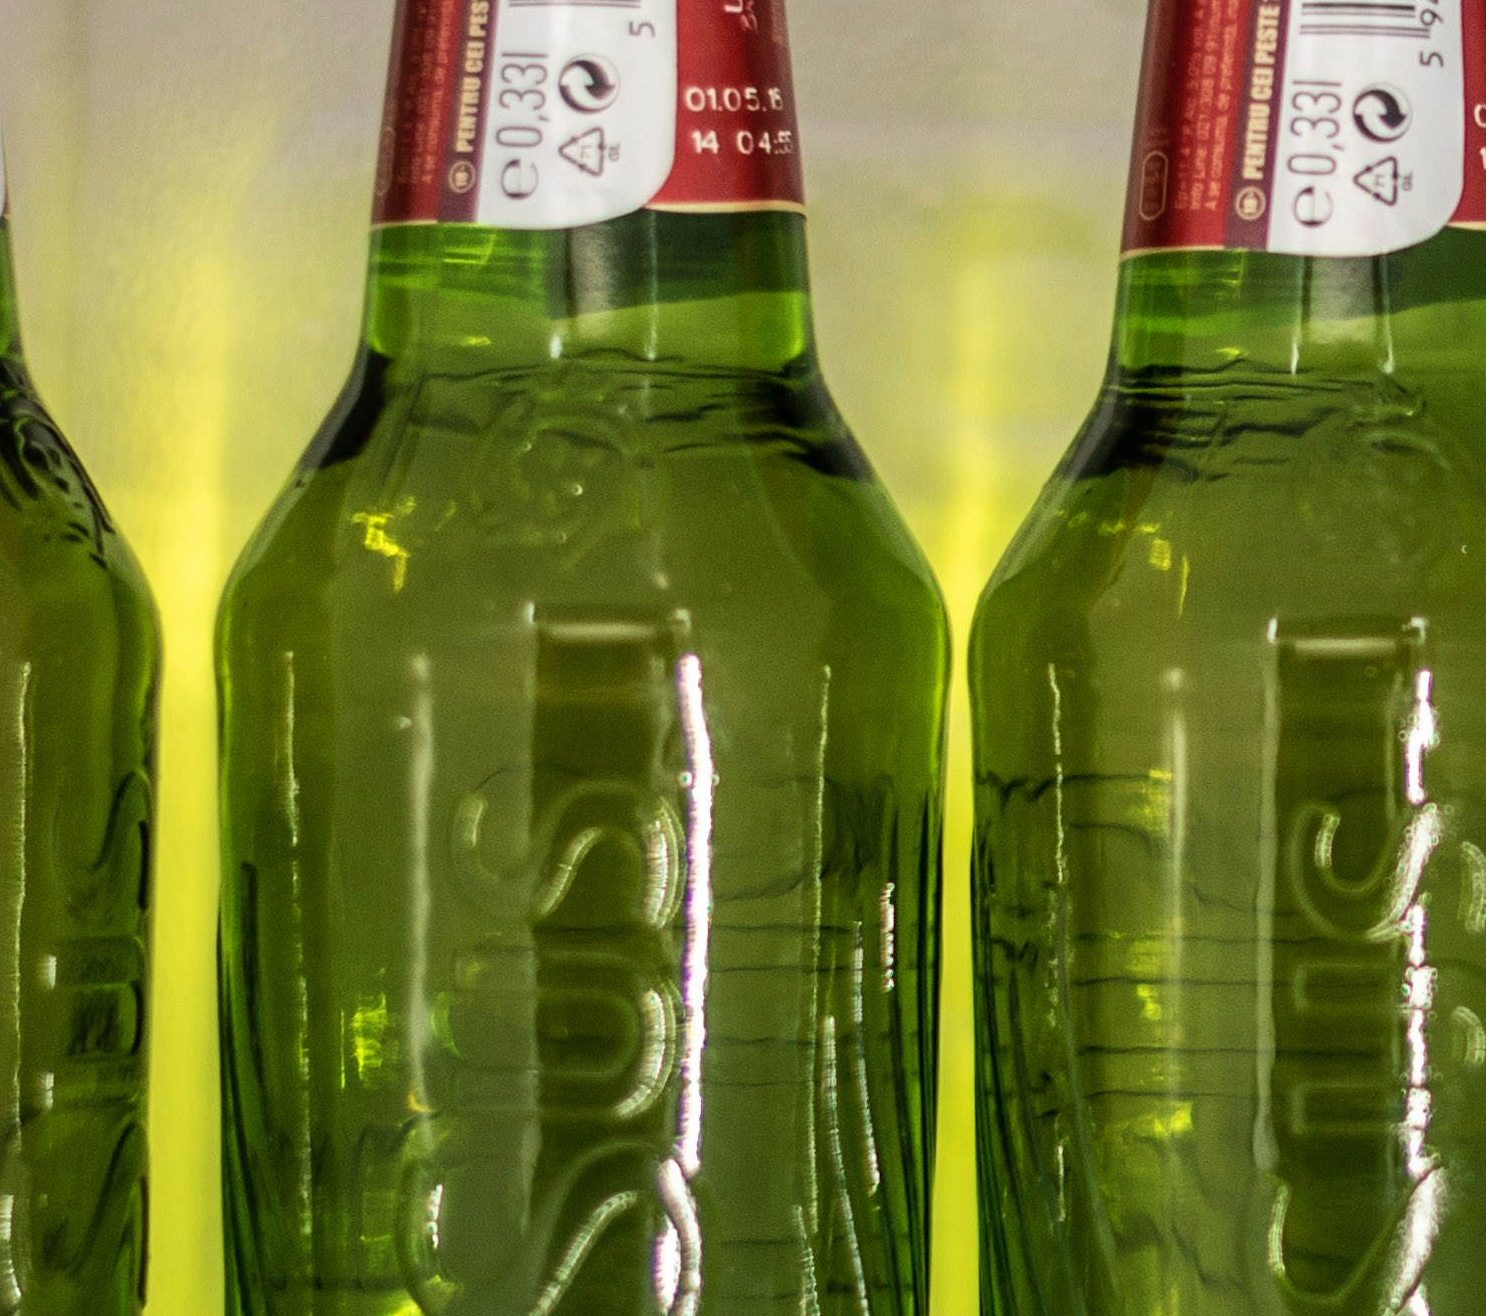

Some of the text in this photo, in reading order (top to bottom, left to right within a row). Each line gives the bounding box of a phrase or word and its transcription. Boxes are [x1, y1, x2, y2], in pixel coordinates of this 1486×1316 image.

[466, 41, 485, 72] CEI
[1254, 6, 1280, 64] PESTE
[455, 77, 481, 152] PENTRU
[496, 52, 551, 148] 0,33l
[1251, 68, 1274, 100] CEI
[692, 130, 719, 154] 14
[1243, 104, 1270, 179] PENTRU
[1287, 81, 1344, 175] 0,33l
